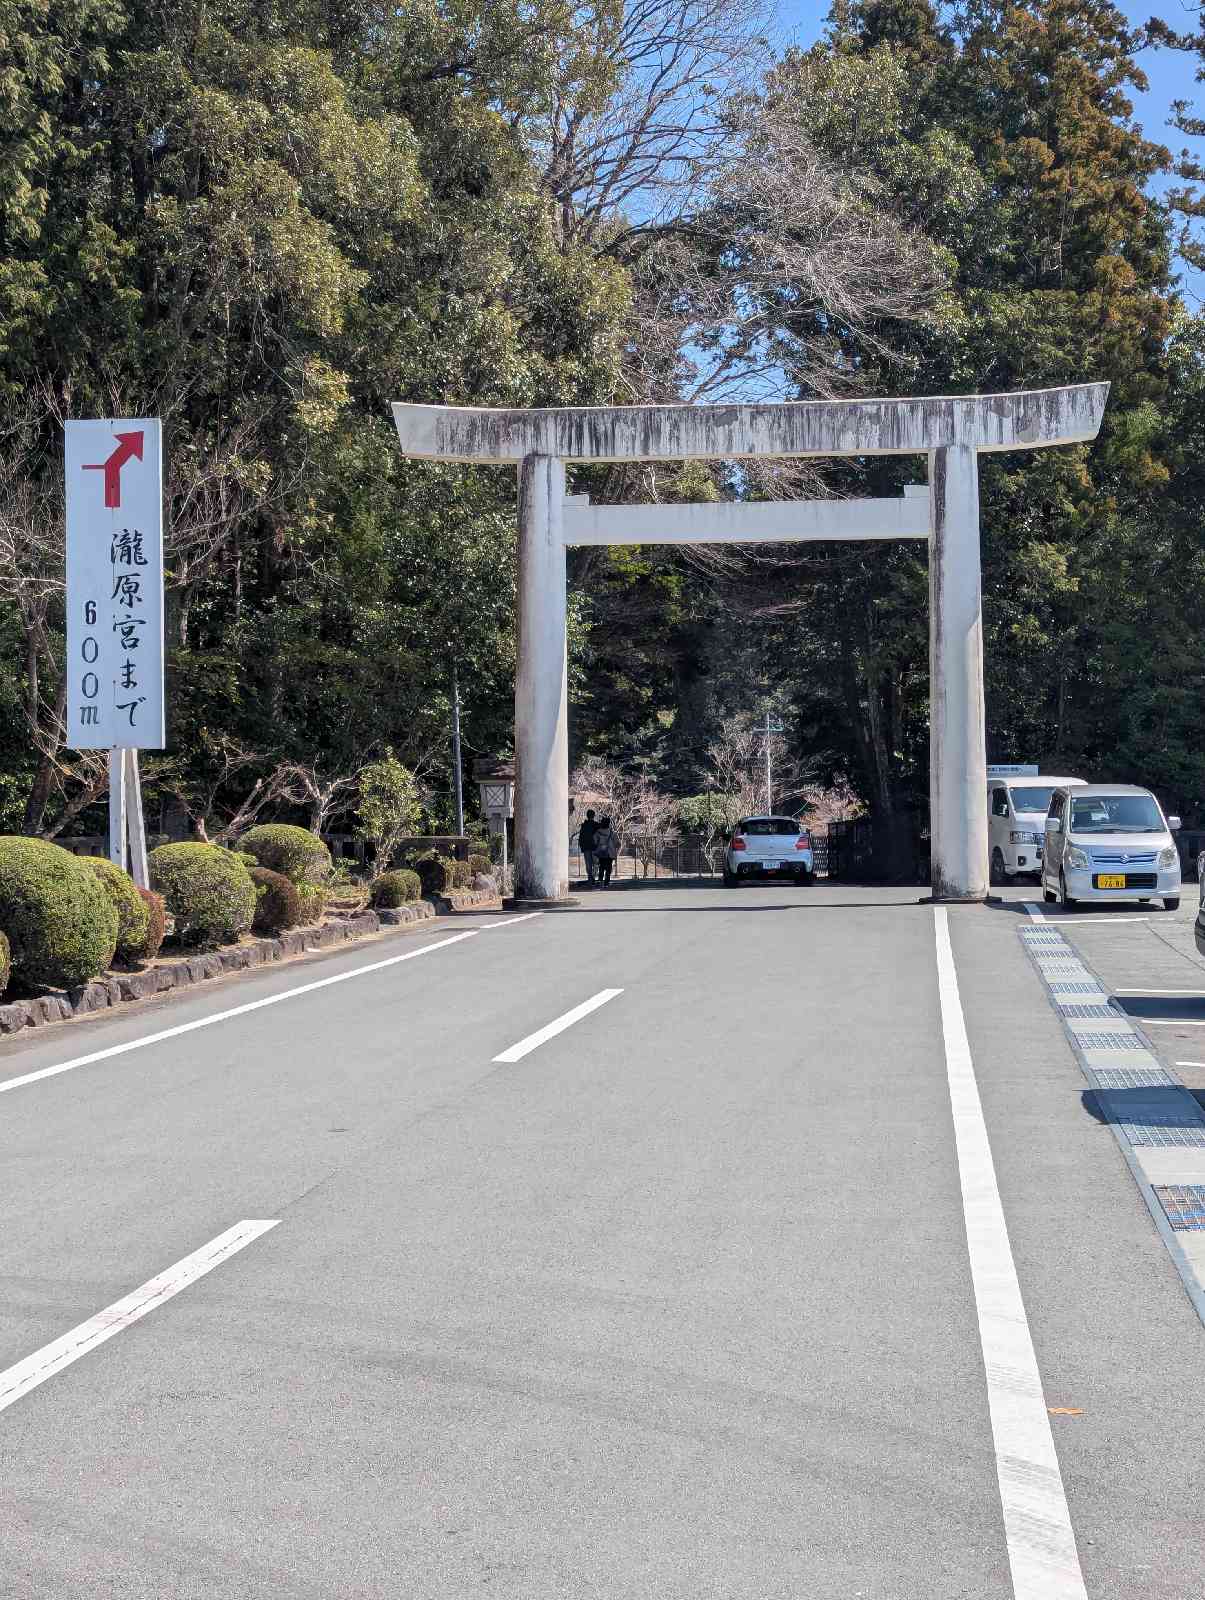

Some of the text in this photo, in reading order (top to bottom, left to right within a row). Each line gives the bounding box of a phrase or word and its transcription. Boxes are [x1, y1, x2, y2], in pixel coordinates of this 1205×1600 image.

[79, 600, 100, 726] 600m
[110, 528, 149, 727] 瀧原宮まで
